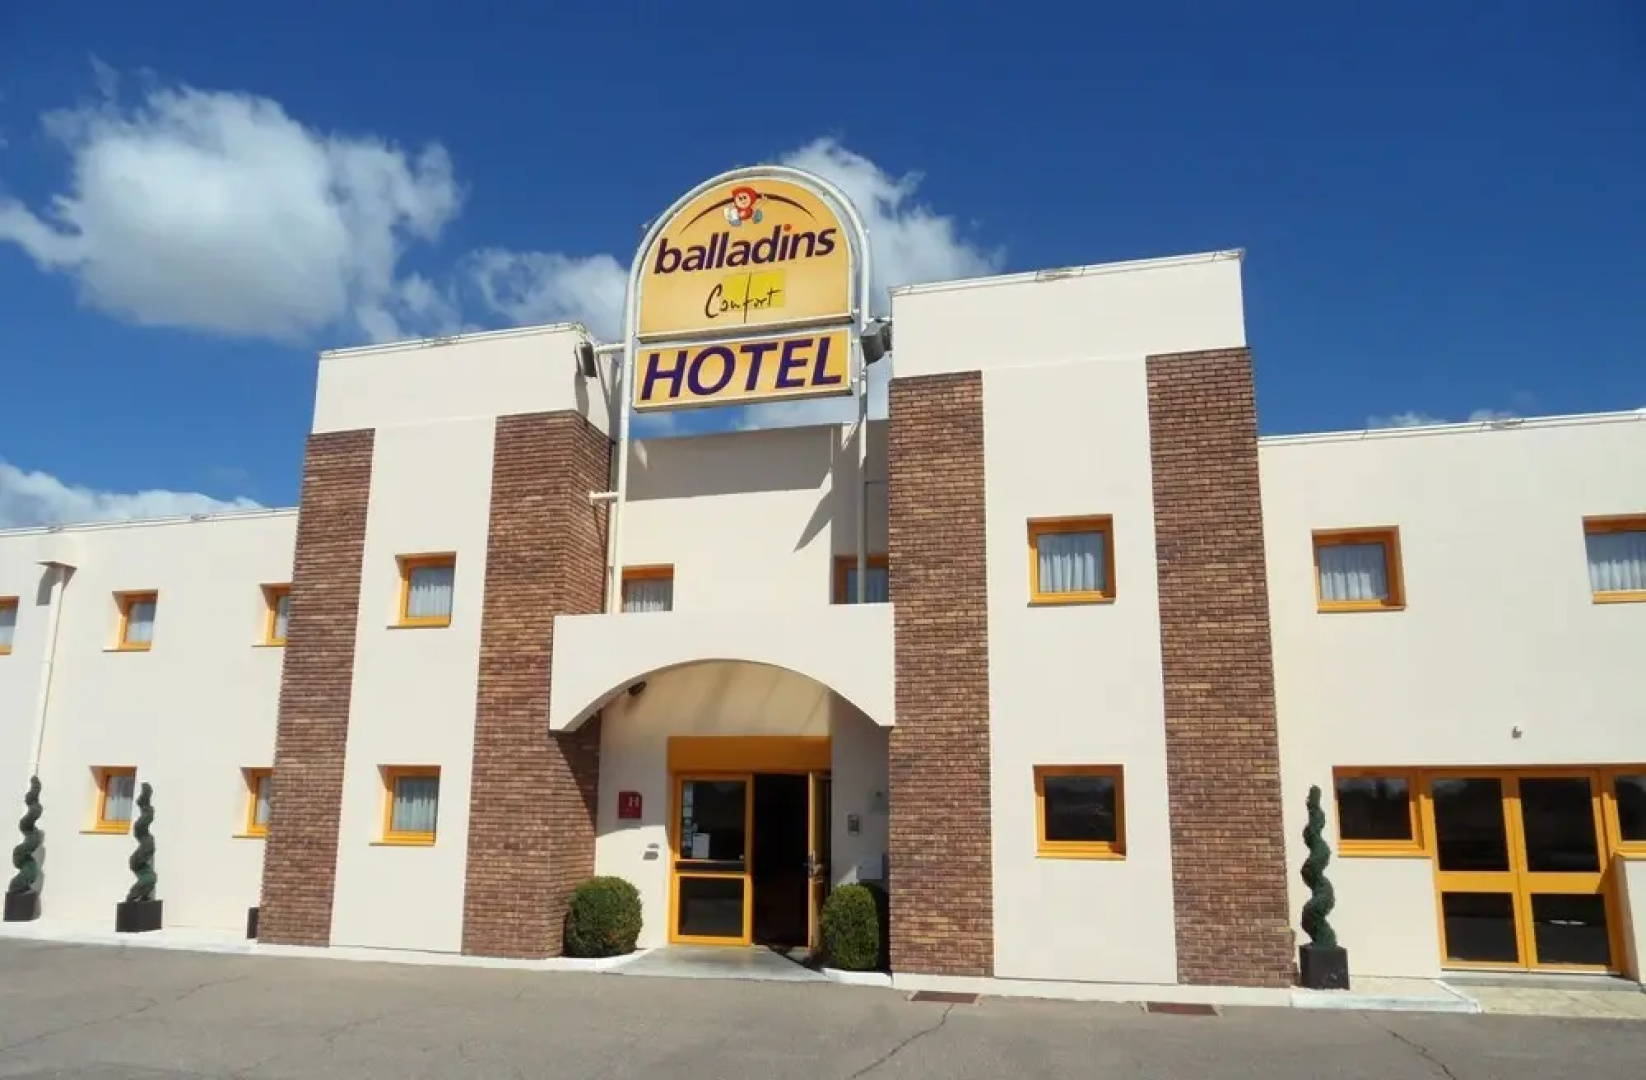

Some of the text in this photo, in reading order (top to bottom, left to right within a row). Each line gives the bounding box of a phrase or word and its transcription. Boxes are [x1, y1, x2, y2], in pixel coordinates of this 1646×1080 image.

[654, 224, 836, 274] balladins
[705, 272, 782, 323] Comfort
[641, 337, 842, 400] HOTEL
[628, 796, 640, 807] H
